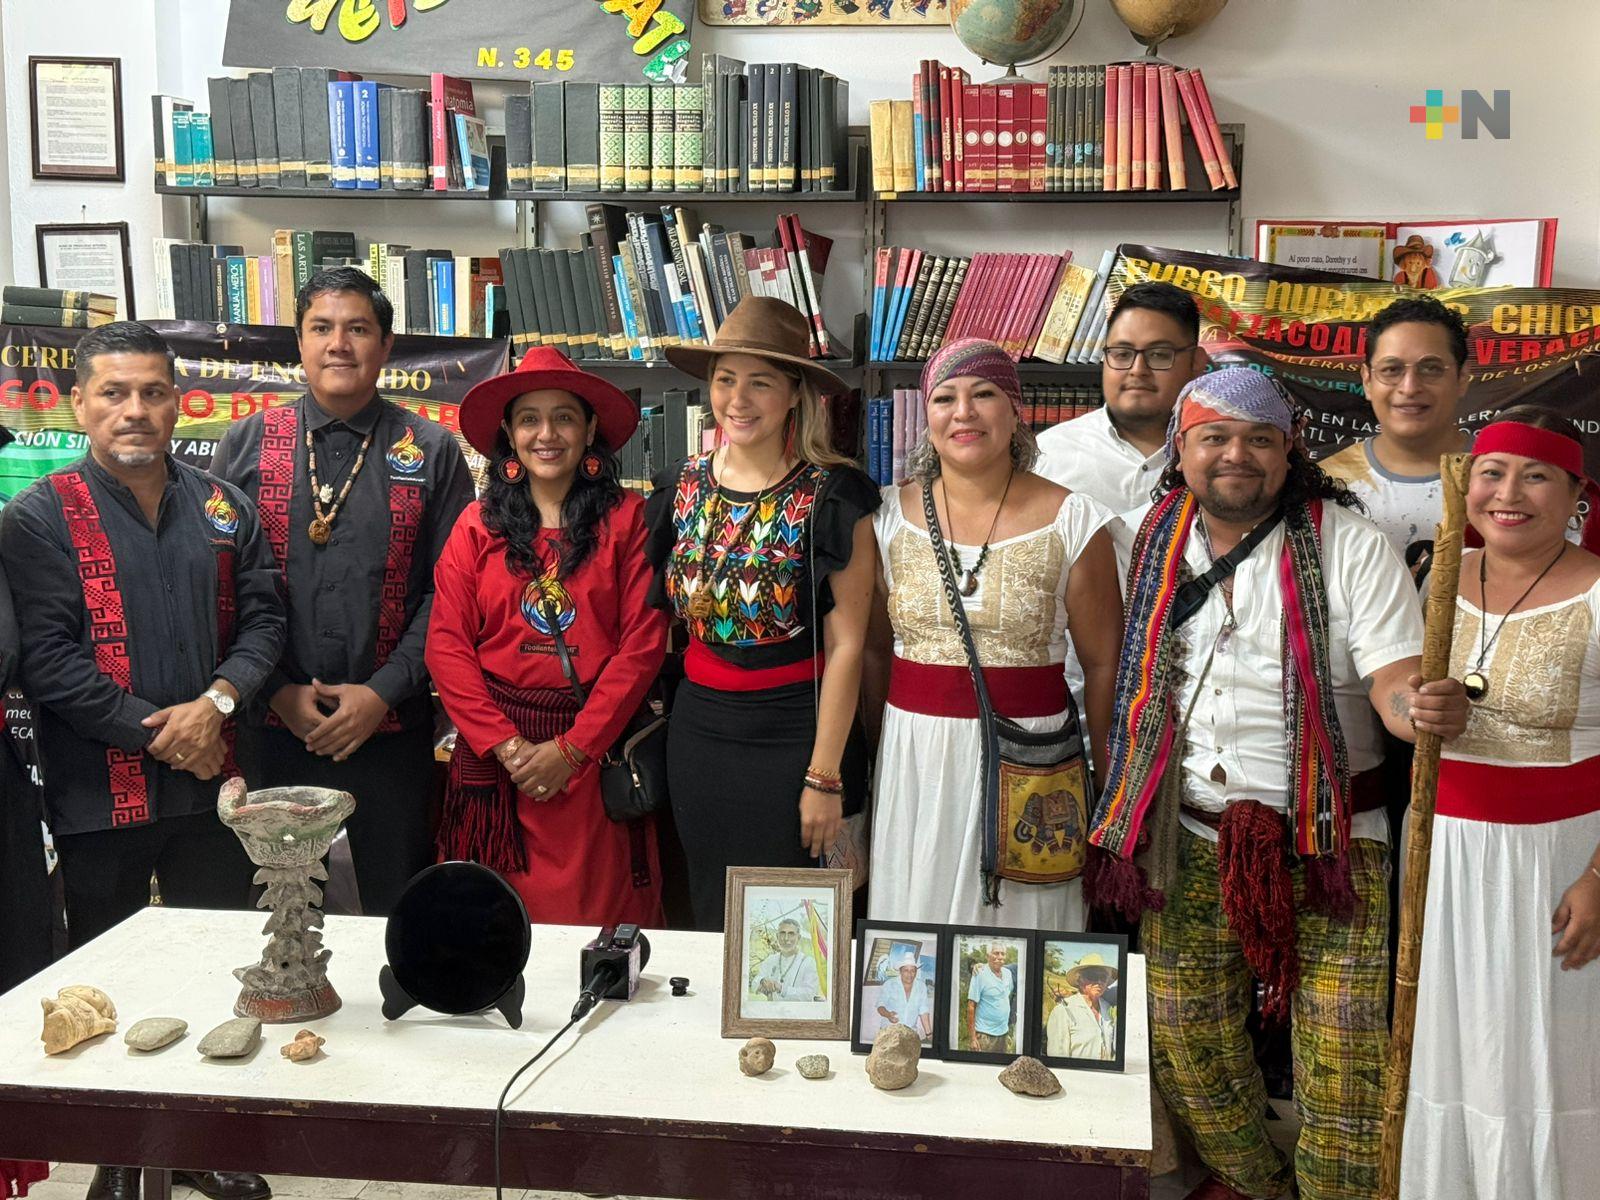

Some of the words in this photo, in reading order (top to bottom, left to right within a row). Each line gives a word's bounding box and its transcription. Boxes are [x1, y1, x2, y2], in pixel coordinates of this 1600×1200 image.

[477, 47, 504, 67] N.
[513, 47, 575, 71] 345
[952, 71, 960, 80] 2
[361, 89, 368, 98] 2
[297, 234, 305, 251] LAS
[667, 227, 678, 249] ATLAS
[299, 252, 308, 285] ARTES
[672, 248, 687, 285] UNIVERSAL
[1491, 303, 1600, 335] CHIC
[1476, 326, 1600, 366] VERAC
[200, 357, 240, 380] DE
[1321, 412, 1345, 427] EN
